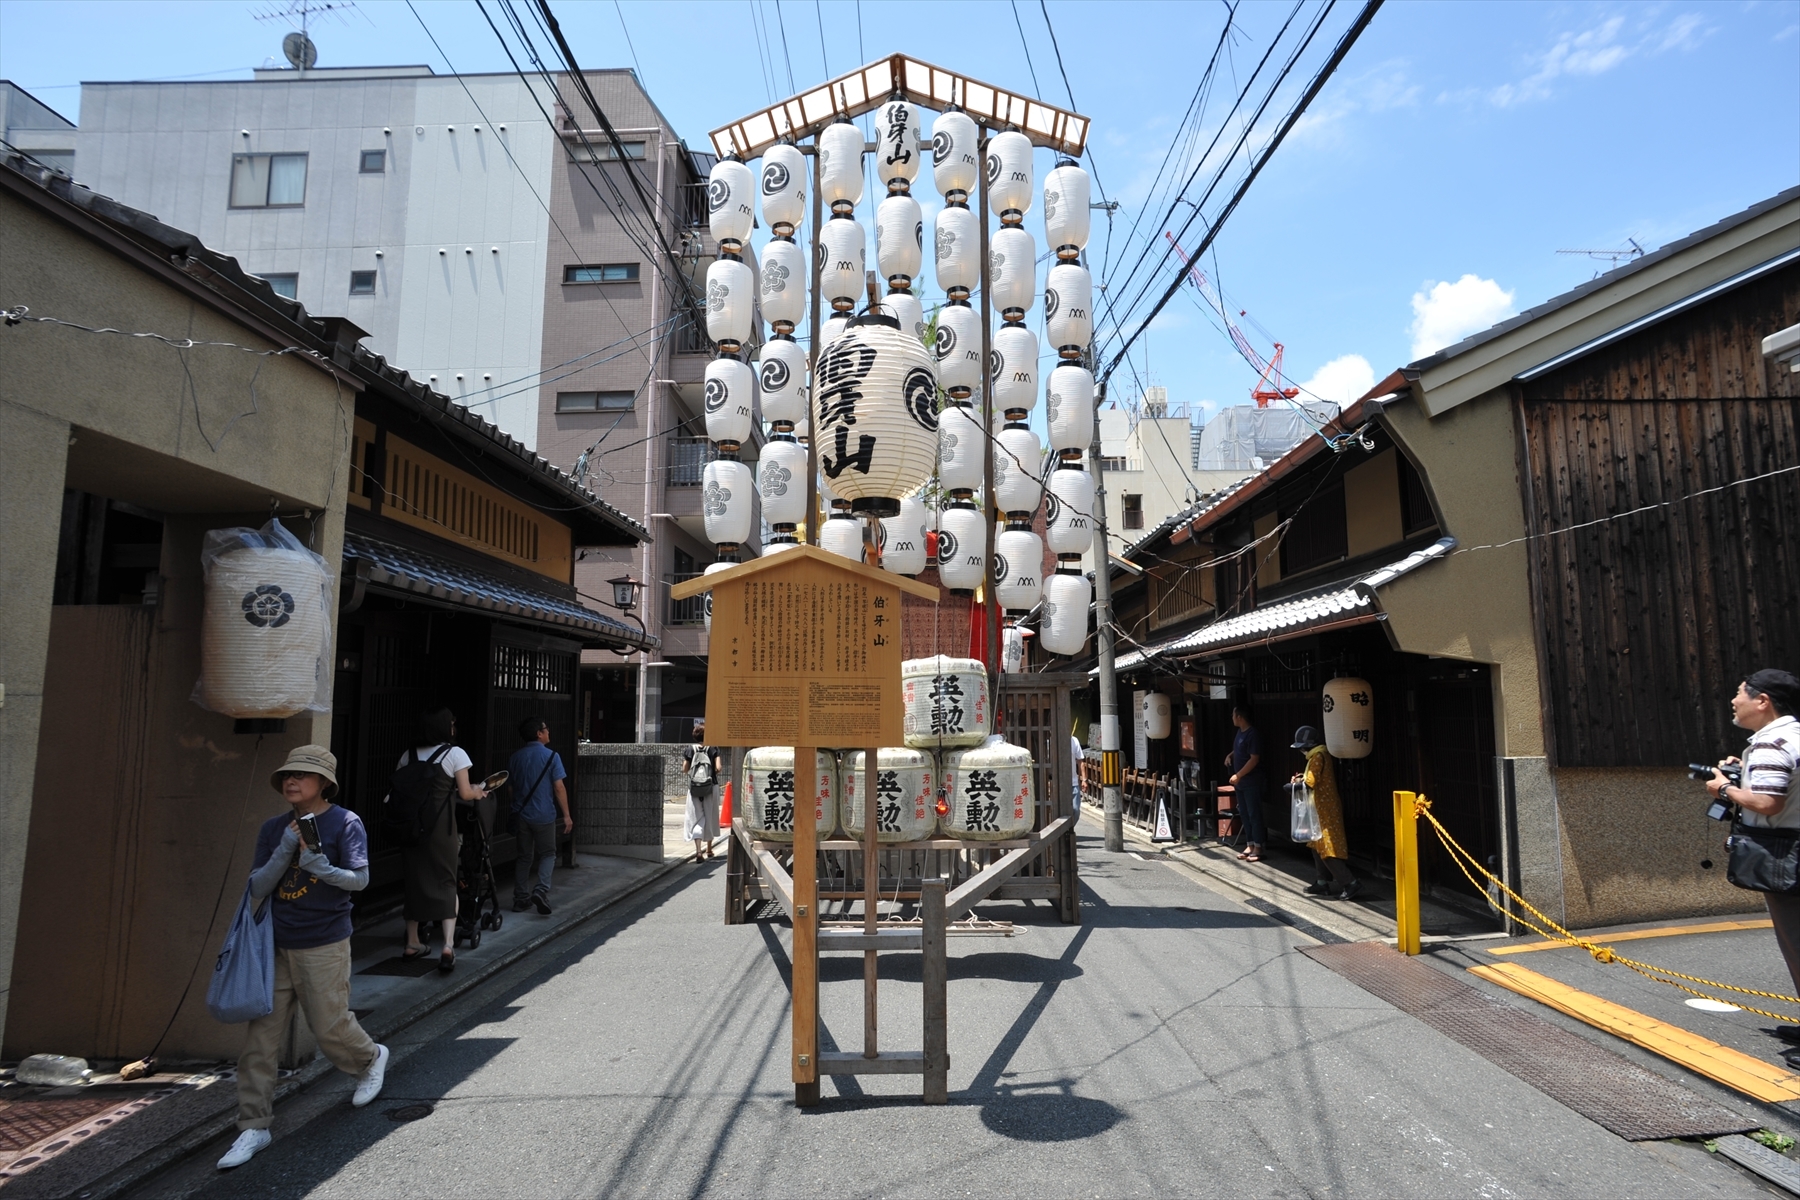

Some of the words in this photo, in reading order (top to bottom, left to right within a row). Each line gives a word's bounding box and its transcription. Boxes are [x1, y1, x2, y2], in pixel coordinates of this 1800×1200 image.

[886, 103, 911, 166] 伯牙山
[816, 334, 877, 479] 伯牙山
[873, 596, 885, 646] 伯牙山
